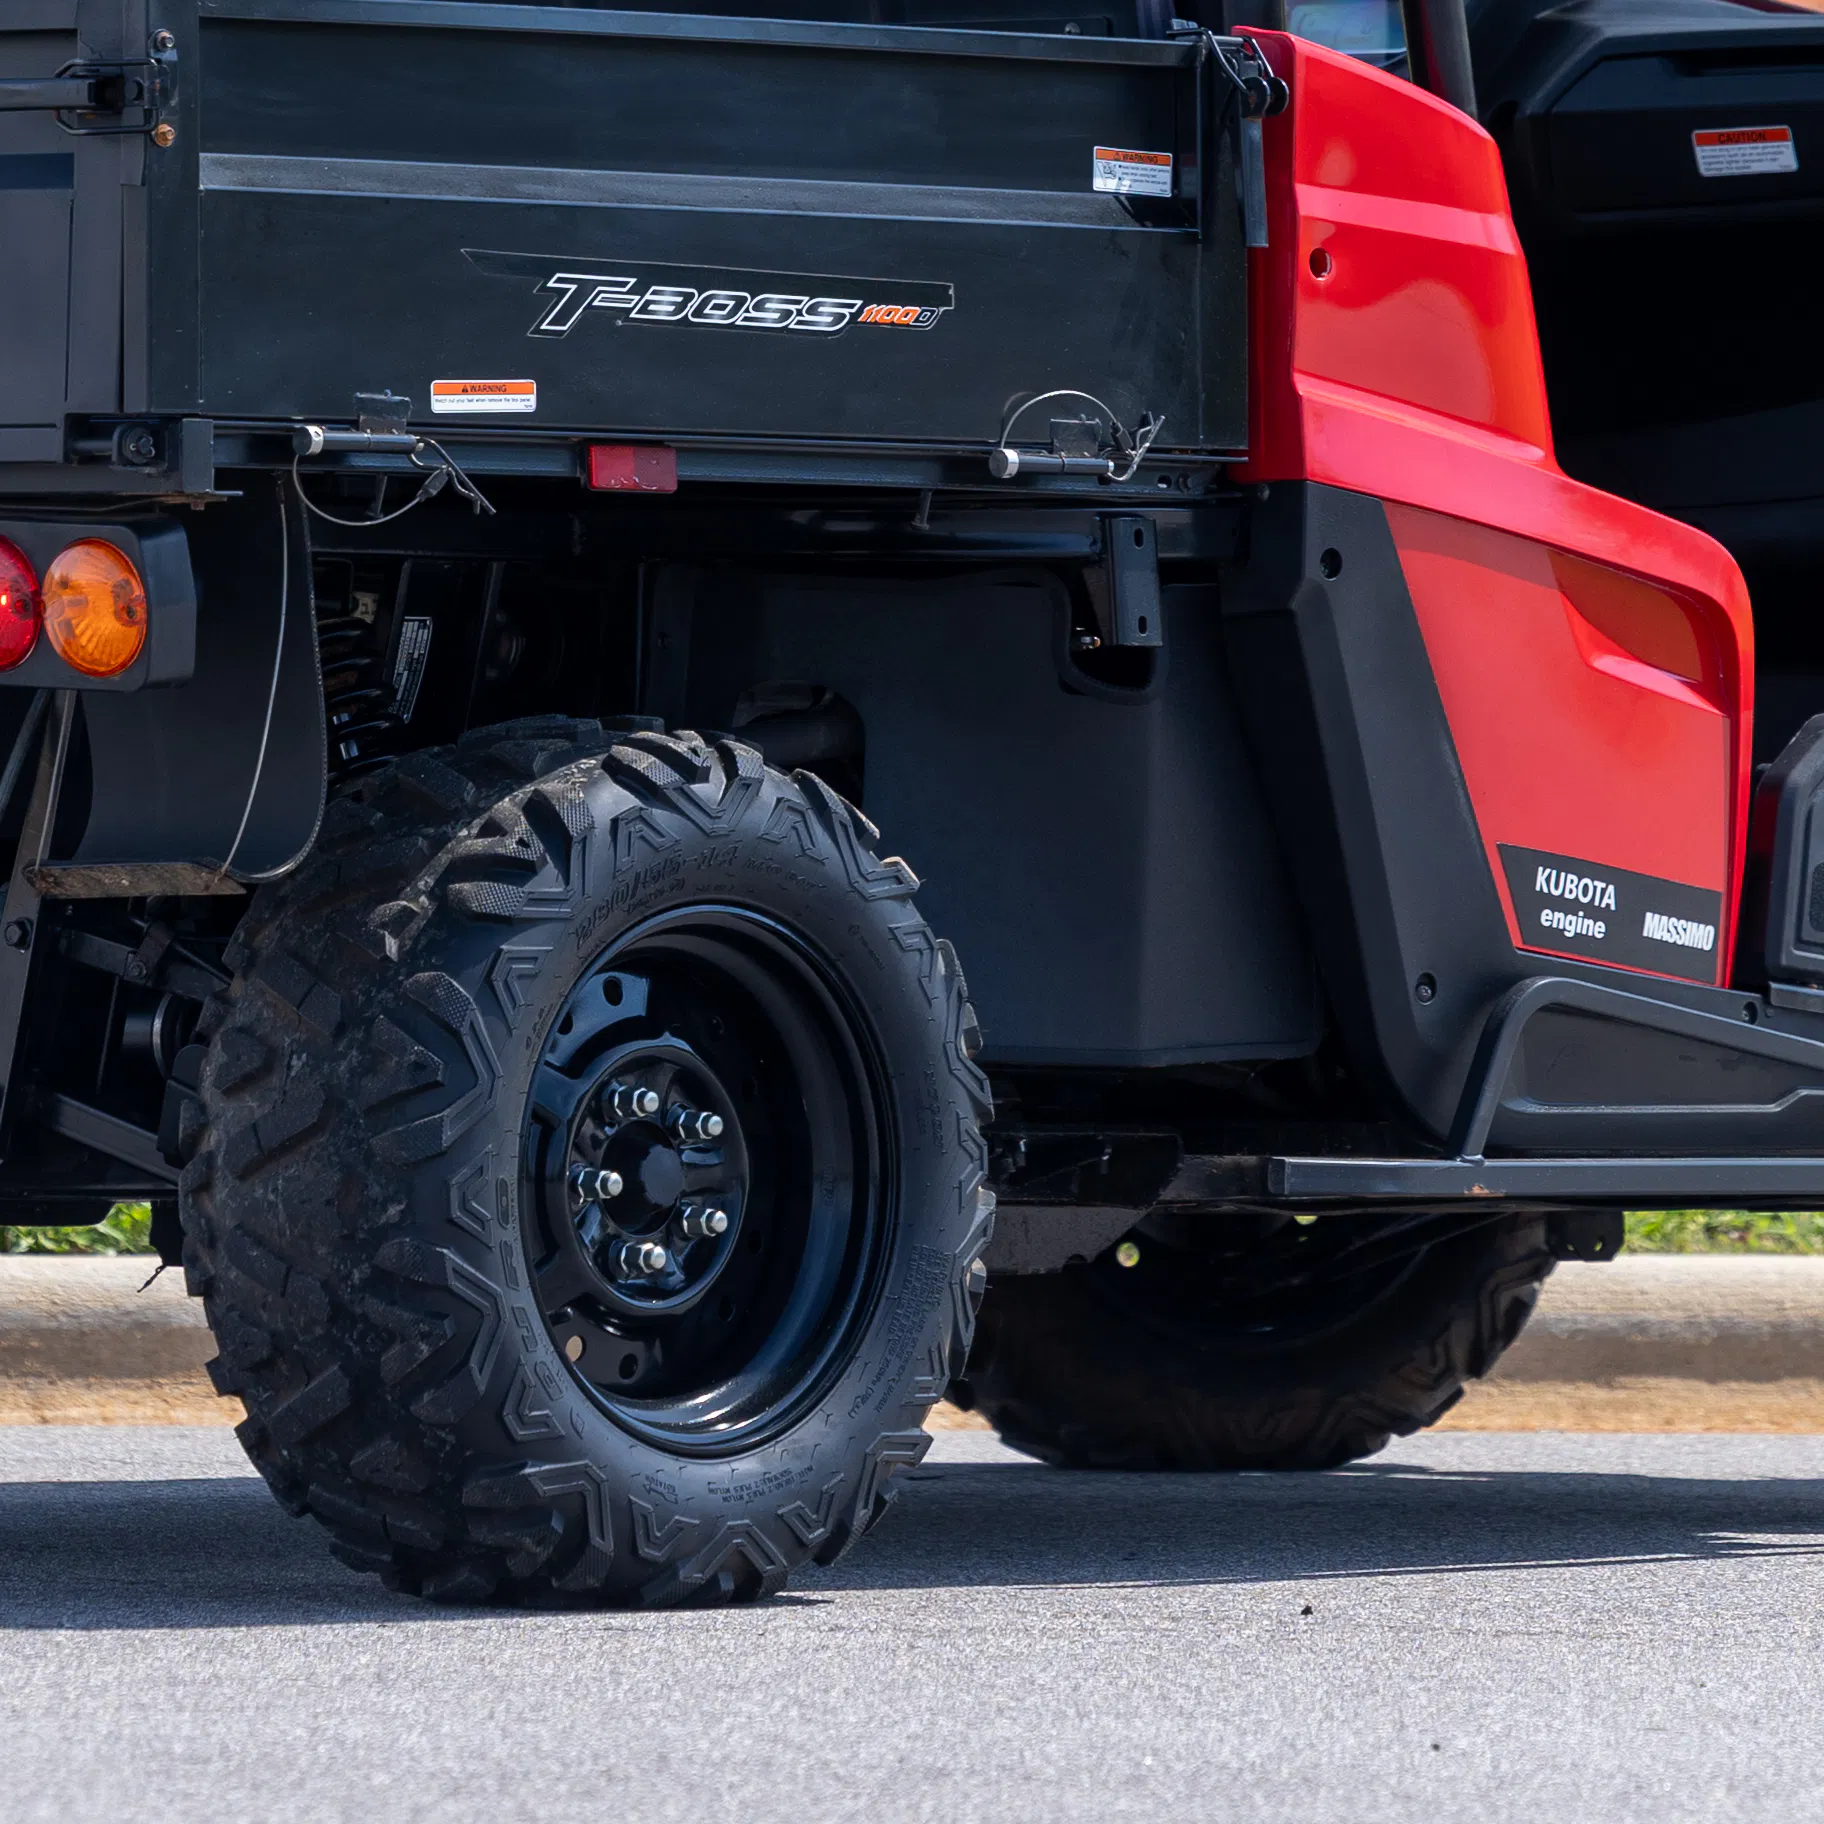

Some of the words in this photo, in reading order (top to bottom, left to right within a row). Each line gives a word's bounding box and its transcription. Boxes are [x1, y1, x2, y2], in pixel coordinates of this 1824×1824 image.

[1718, 131, 1767, 143] CAUTION
[1122, 153, 1159, 164] WARNING
[540, 272, 862, 331] T-BOSS
[857, 304, 940, 326] 1100D
[470, 384, 507, 393] WARNING
[1535, 866, 1616, 910] KUBOTA
[1540, 908, 1606, 938] engine
[1642, 911, 1715, 951] MASSIMO
